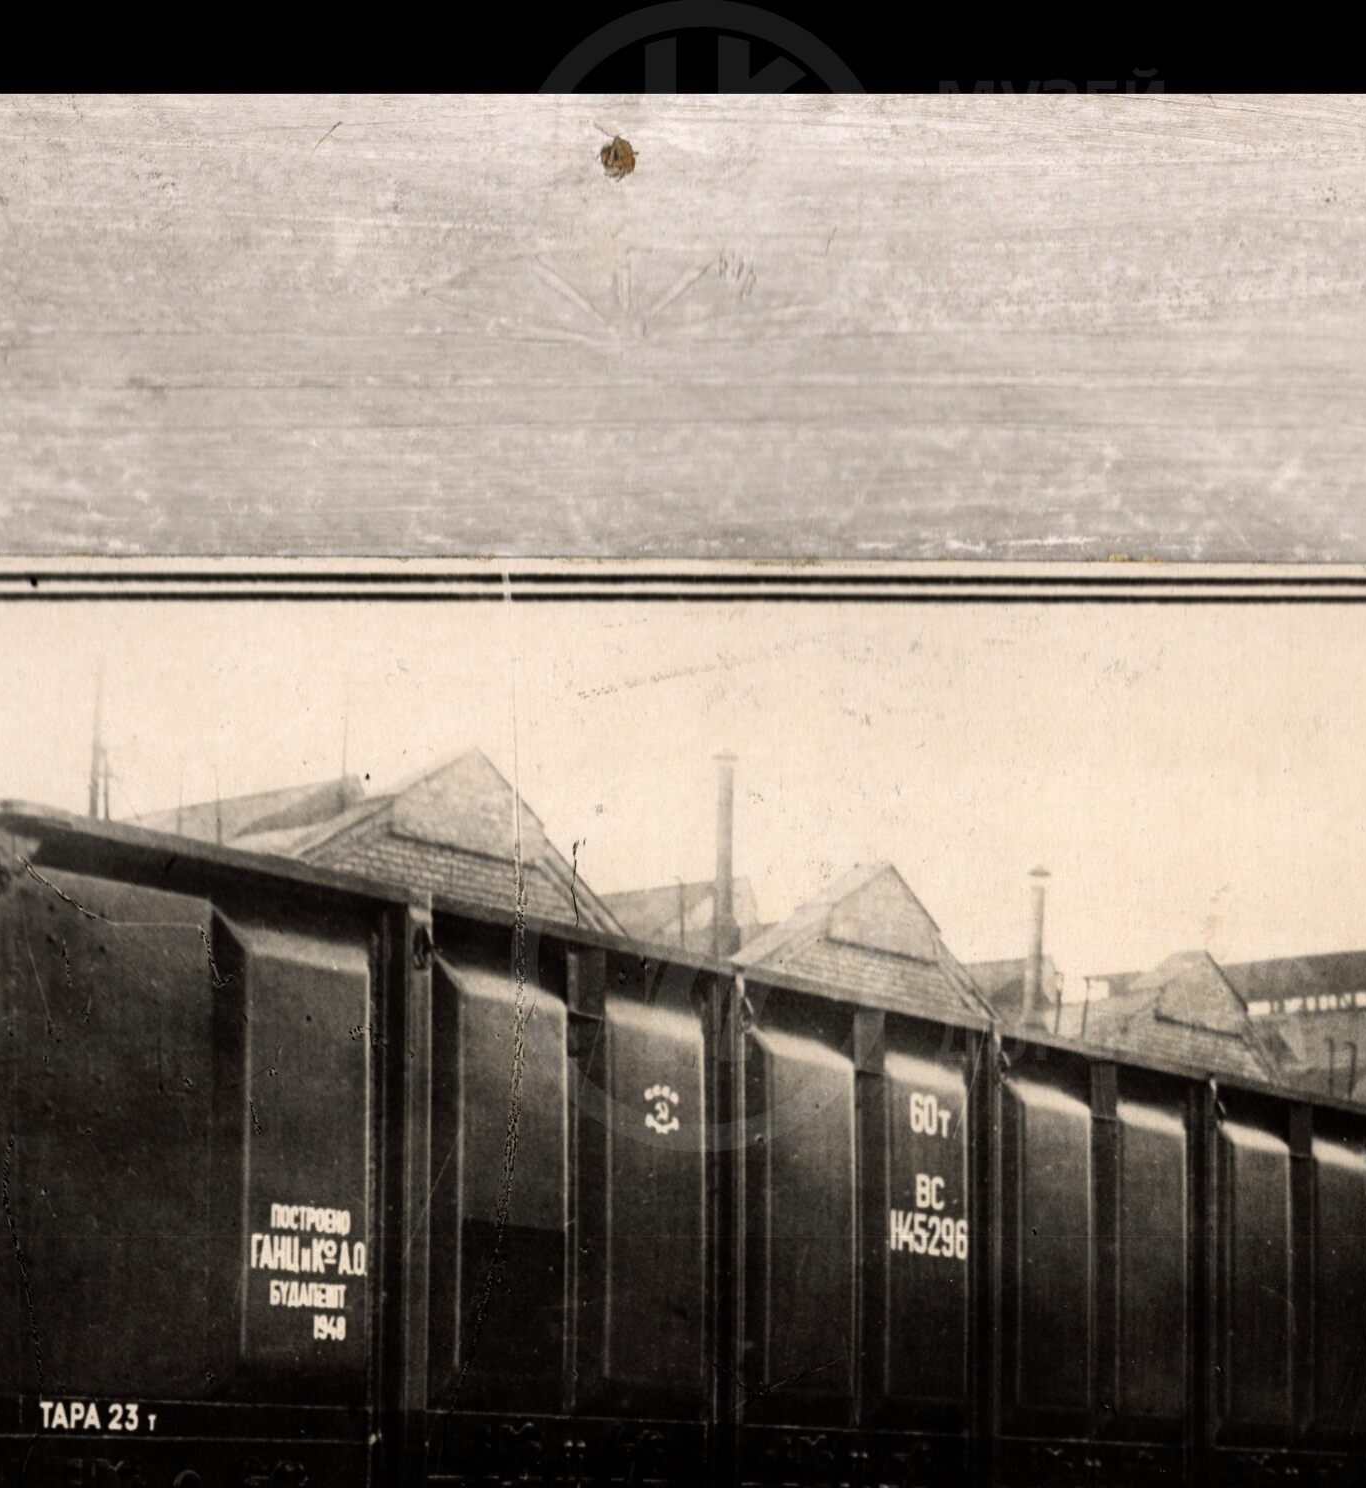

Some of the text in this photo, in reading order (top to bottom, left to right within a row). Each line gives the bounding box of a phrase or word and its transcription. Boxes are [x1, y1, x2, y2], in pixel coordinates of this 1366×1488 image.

[915, 1173, 946, 1211] ВС
[271, 1203, 350, 1236] ПОСТРОЕНО
[250, 1233, 300, 1273] ГАНЦ
[270, 1280, 346, 1308] БУДАПЕШТ
[314, 1315, 346, 1341] 1948
[39, 1401, 101, 1429] ТАРА
[108, 1403, 139, 1431] 23
